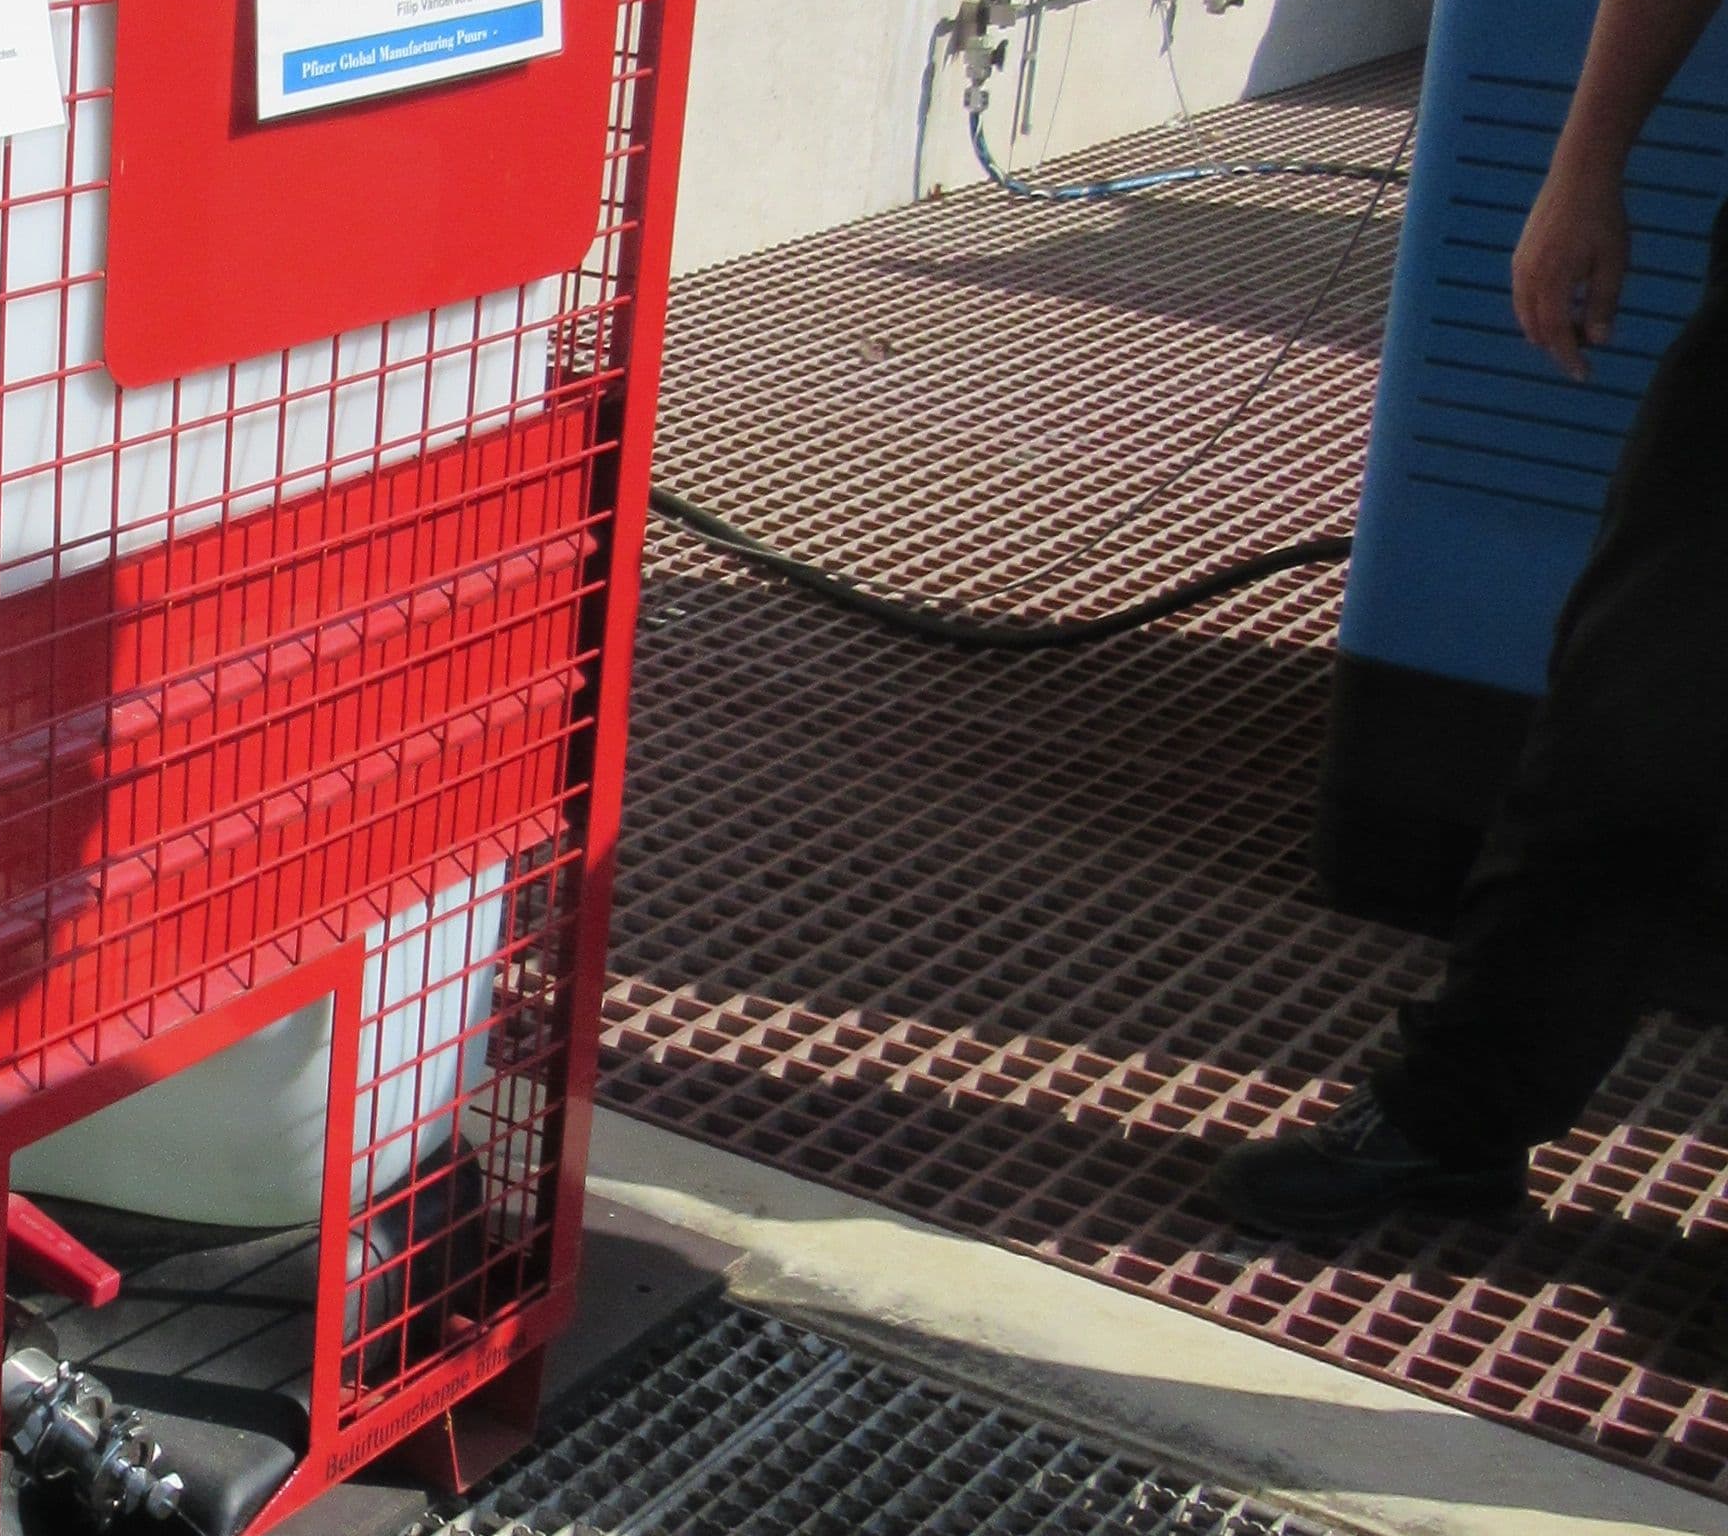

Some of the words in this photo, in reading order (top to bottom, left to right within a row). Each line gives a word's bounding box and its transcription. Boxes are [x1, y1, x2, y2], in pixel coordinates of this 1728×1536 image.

[396, 0, 419, 17] Filip
[301, 59, 338, 80] Pfizer
[339, 48, 377, 72] Global
[379, 33, 455, 63] Manufacturing
[456, 27, 489, 46] Puurs
